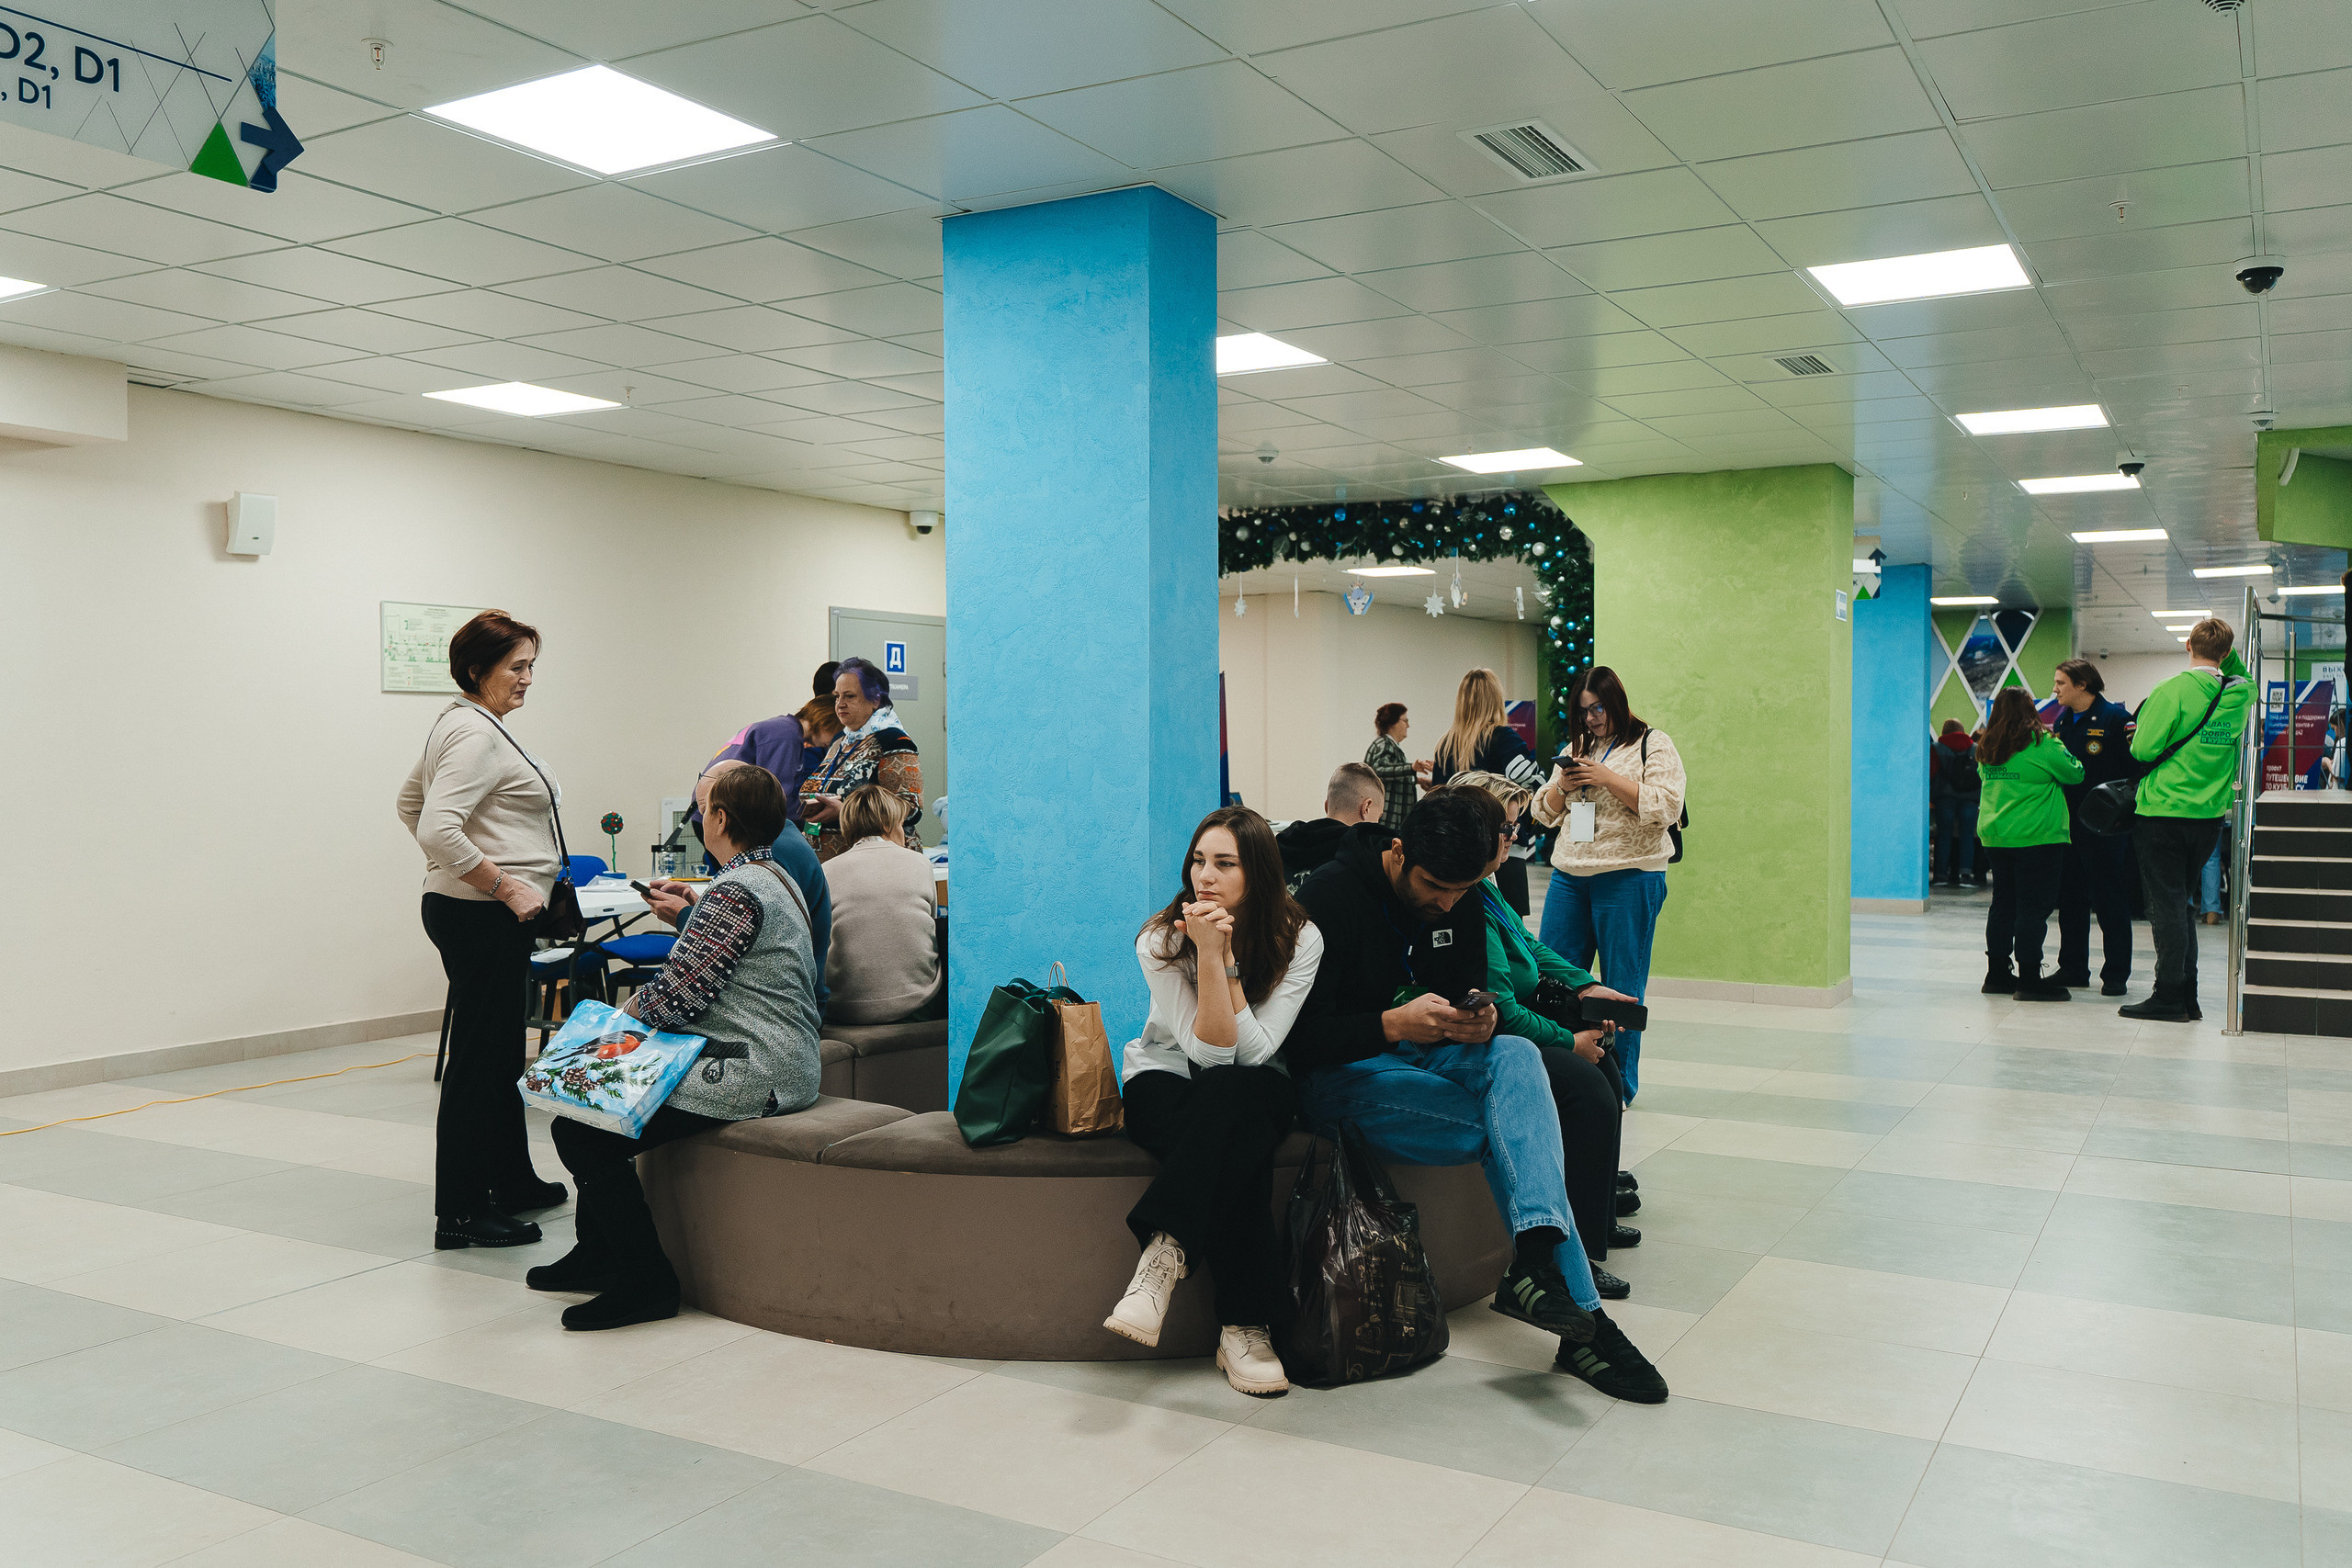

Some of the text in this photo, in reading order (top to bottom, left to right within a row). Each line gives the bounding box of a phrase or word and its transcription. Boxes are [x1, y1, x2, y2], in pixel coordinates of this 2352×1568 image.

[74, 45, 119, 93] D1
[18, 76, 51, 110] D1
[889, 647, 901, 669] Д
